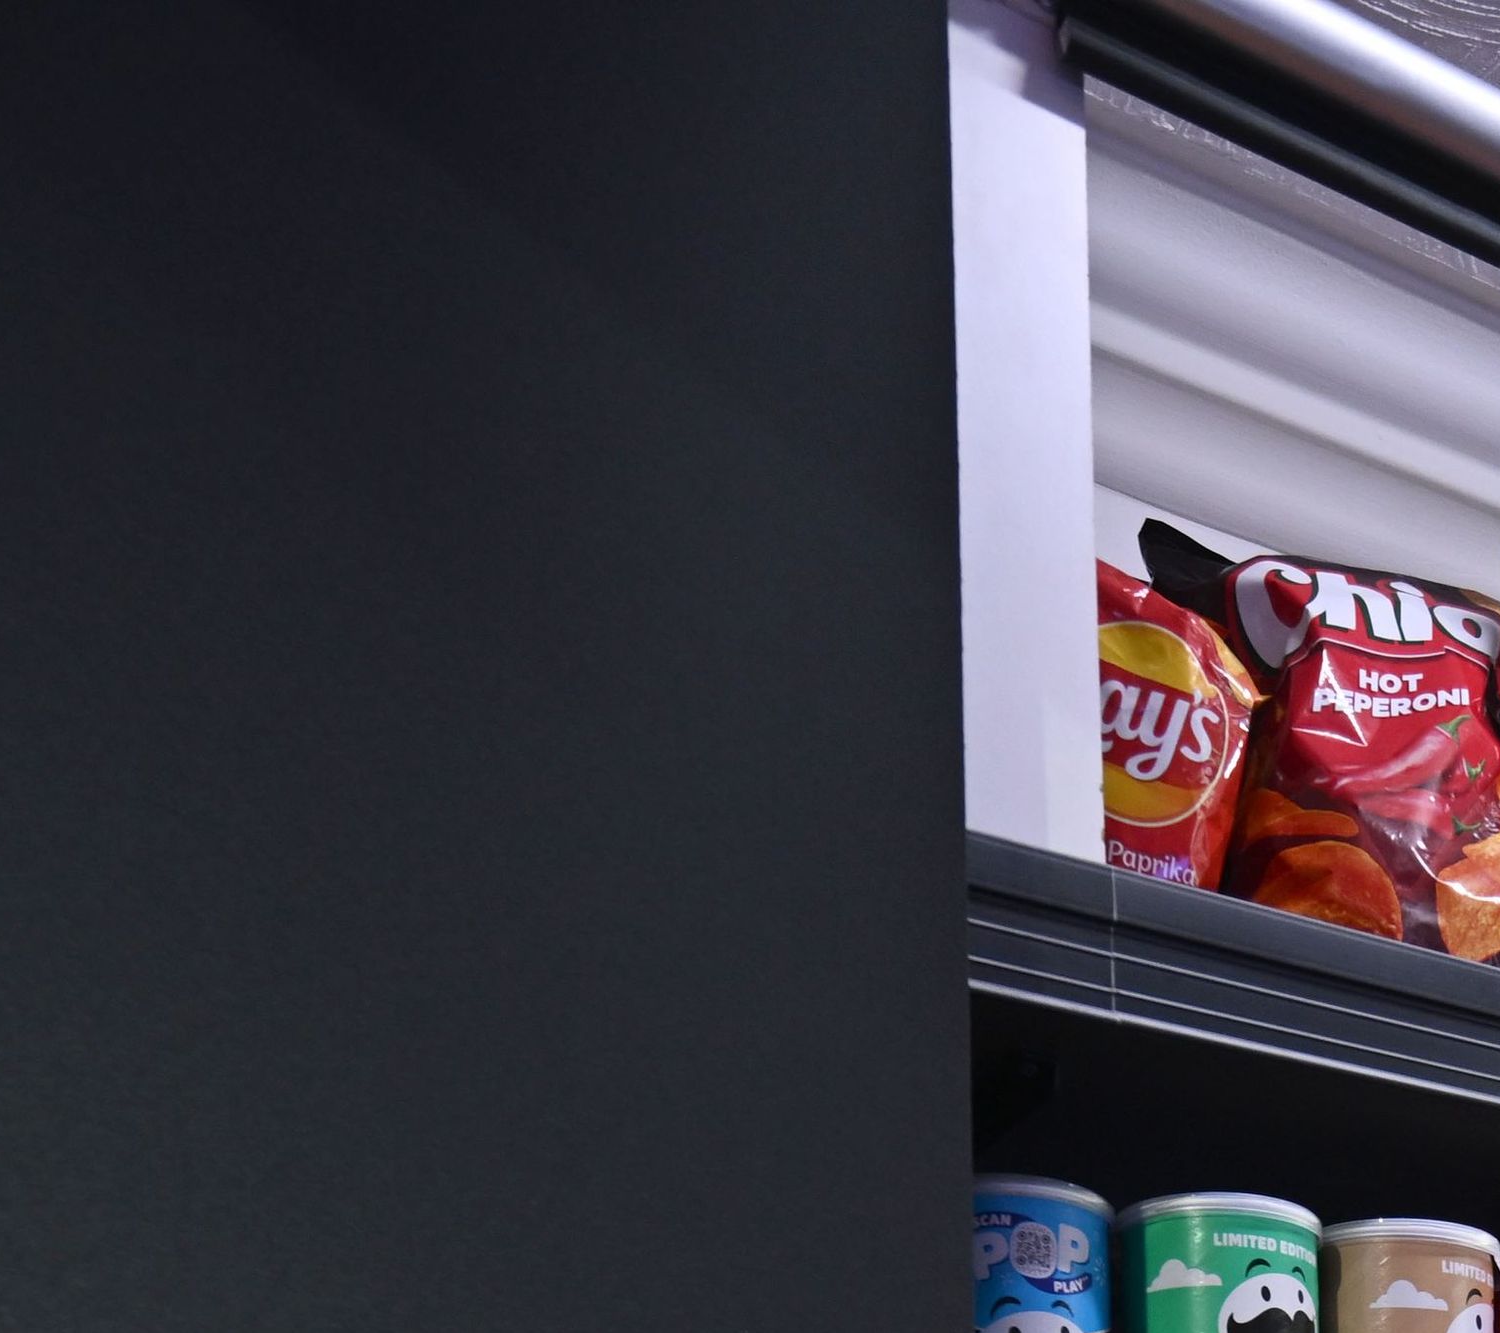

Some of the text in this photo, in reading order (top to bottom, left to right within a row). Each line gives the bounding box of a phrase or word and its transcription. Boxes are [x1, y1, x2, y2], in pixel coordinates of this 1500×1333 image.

[1358, 669, 1423, 693] HOT
[1312, 688, 1470, 718] PEPERONI
[1101, 680, 1219, 781] ay's
[1213, 1232, 1277, 1252] LIMITED
[1441, 1261, 1486, 1283] LIMITED
